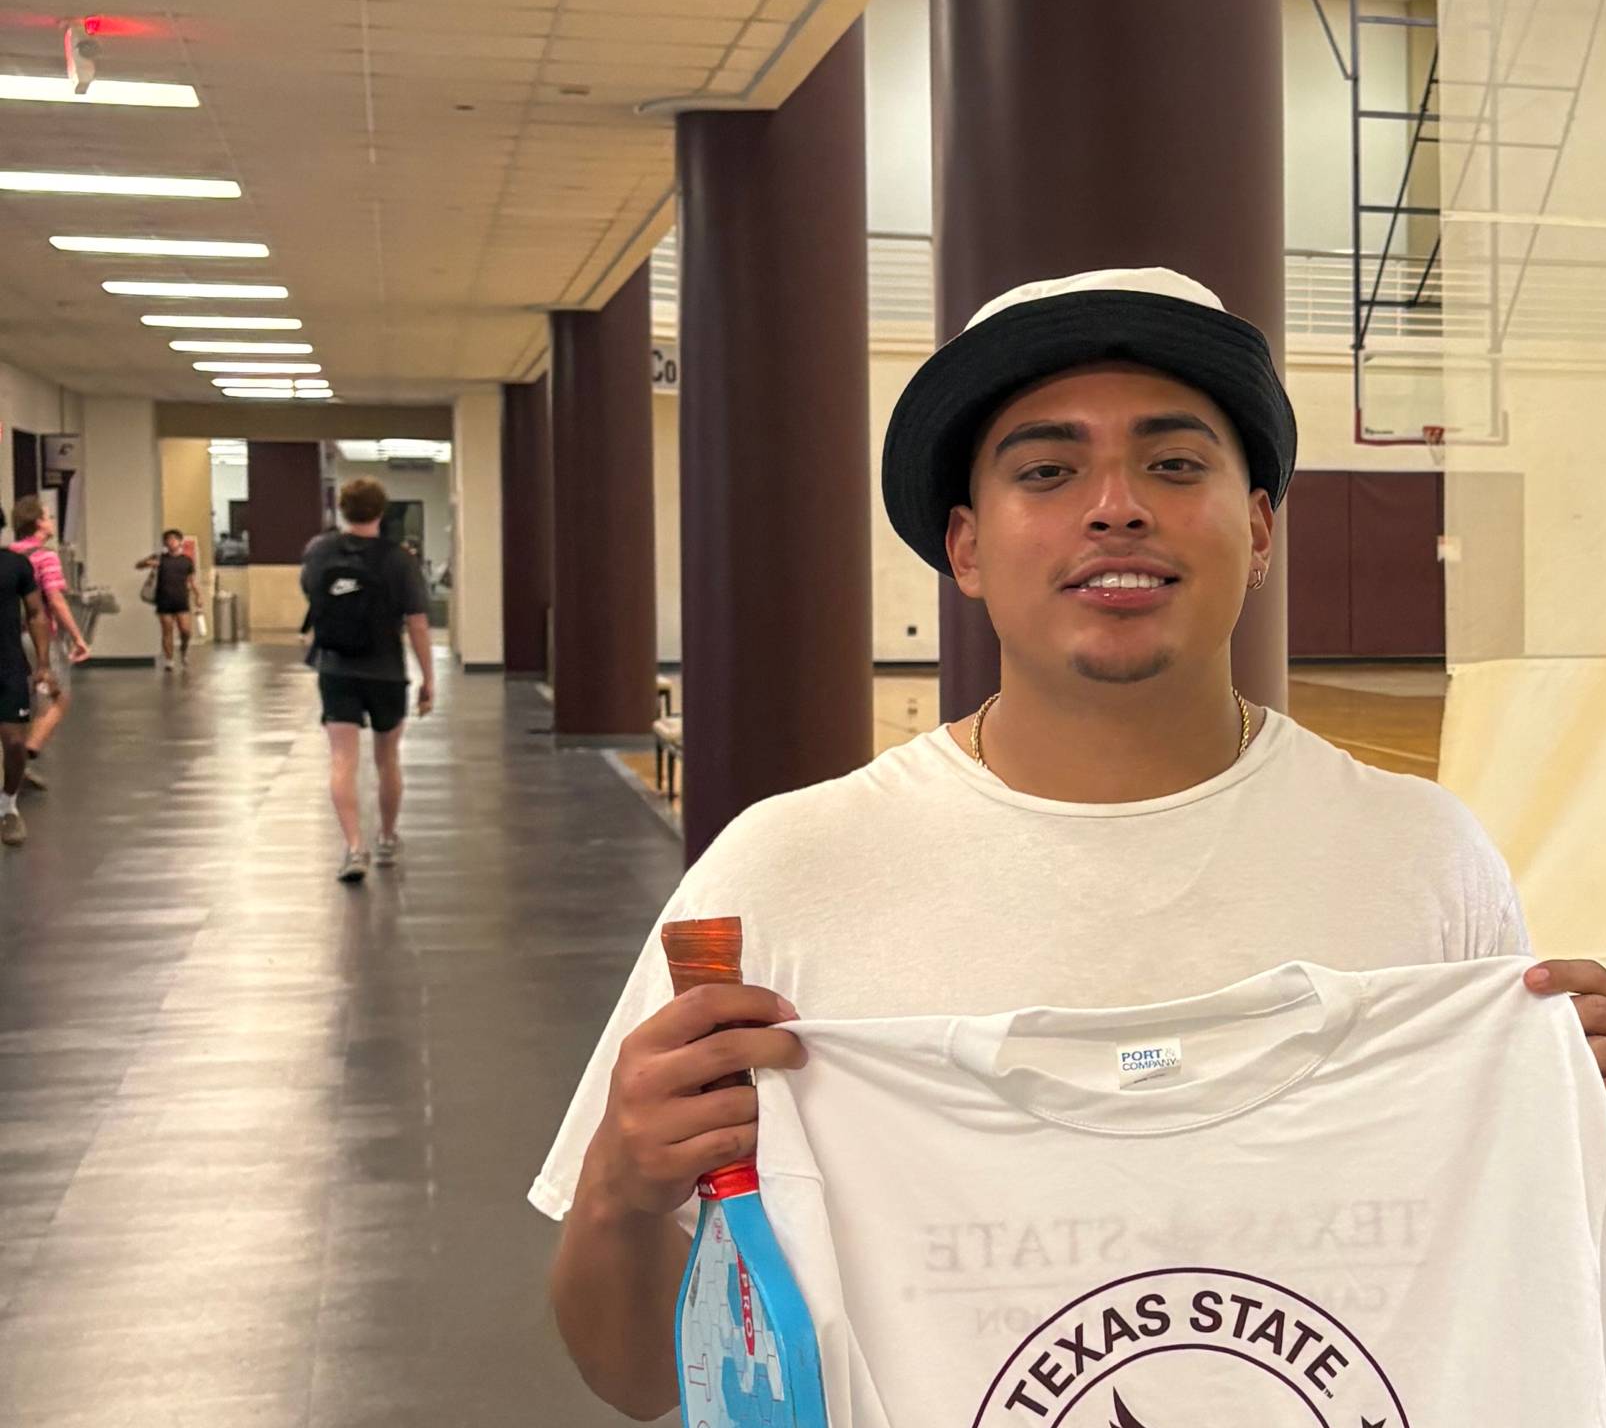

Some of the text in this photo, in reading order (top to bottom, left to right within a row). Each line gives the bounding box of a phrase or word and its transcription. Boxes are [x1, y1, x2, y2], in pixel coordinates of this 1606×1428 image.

[1121, 1048, 1162, 1062] PORT
[1121, 1058, 1178, 1072] COMPANY
[741, 1273, 755, 1339] PRO
[1004, 1290, 1349, 1418] TEXAS STATE
